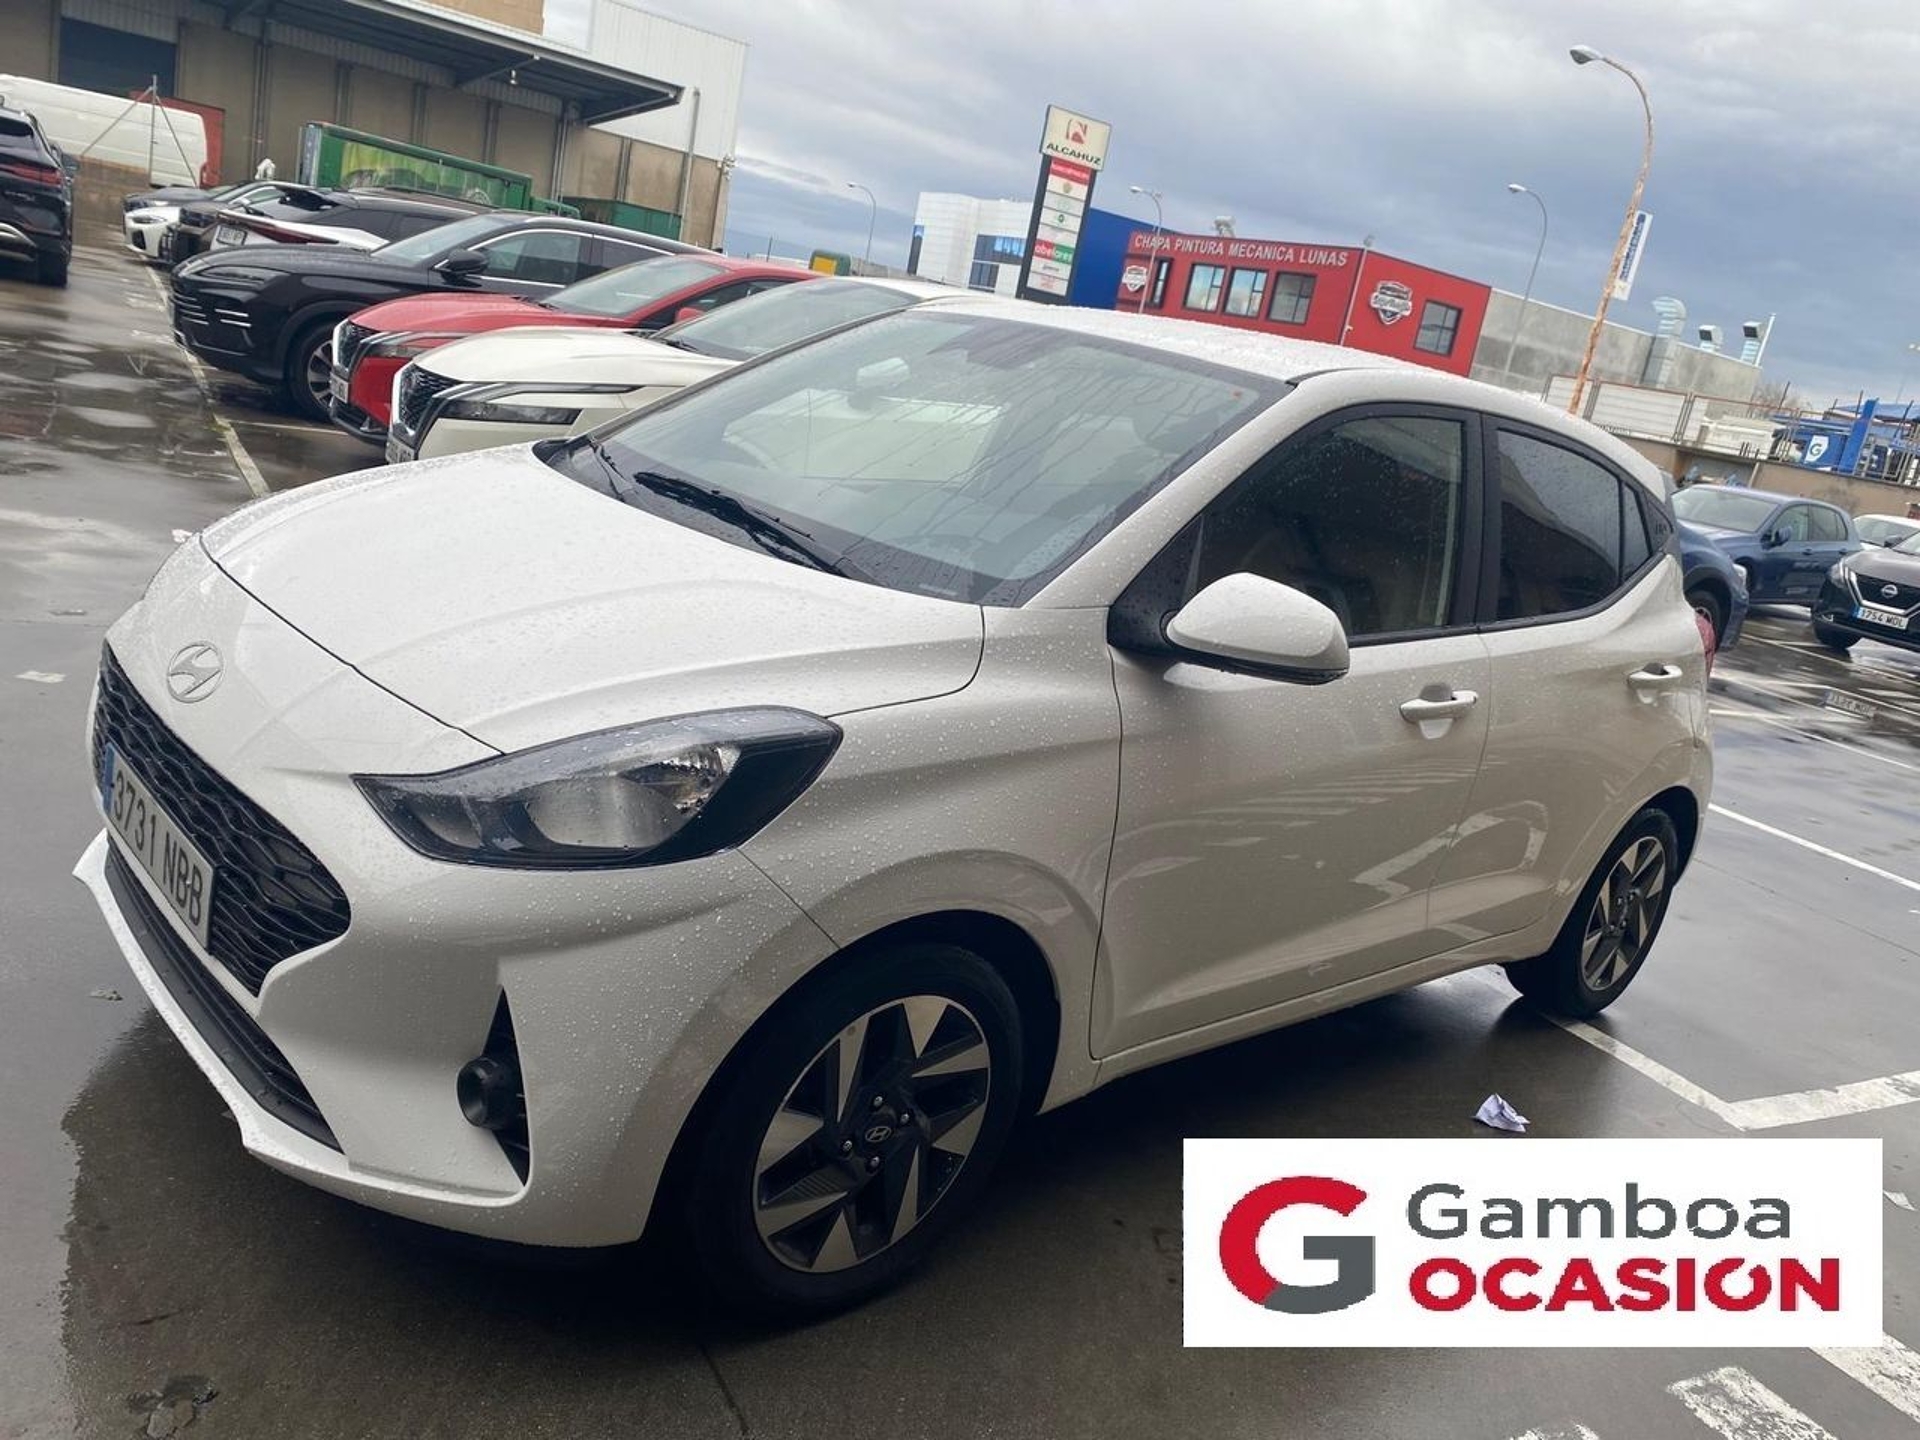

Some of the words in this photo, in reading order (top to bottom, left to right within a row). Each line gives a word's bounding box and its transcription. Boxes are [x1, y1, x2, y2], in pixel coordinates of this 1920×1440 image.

[1046, 143, 1102, 166] ALCAHUZ
[1134, 235, 1171, 251] CHAPA
[1174, 238, 1224, 257] PINTURA
[1228, 242, 1294, 263] MECANICA
[1299, 249, 1348, 267] LUNAS
[114, 769, 157, 867] 3731
[162, 831, 204, 927] NBB
